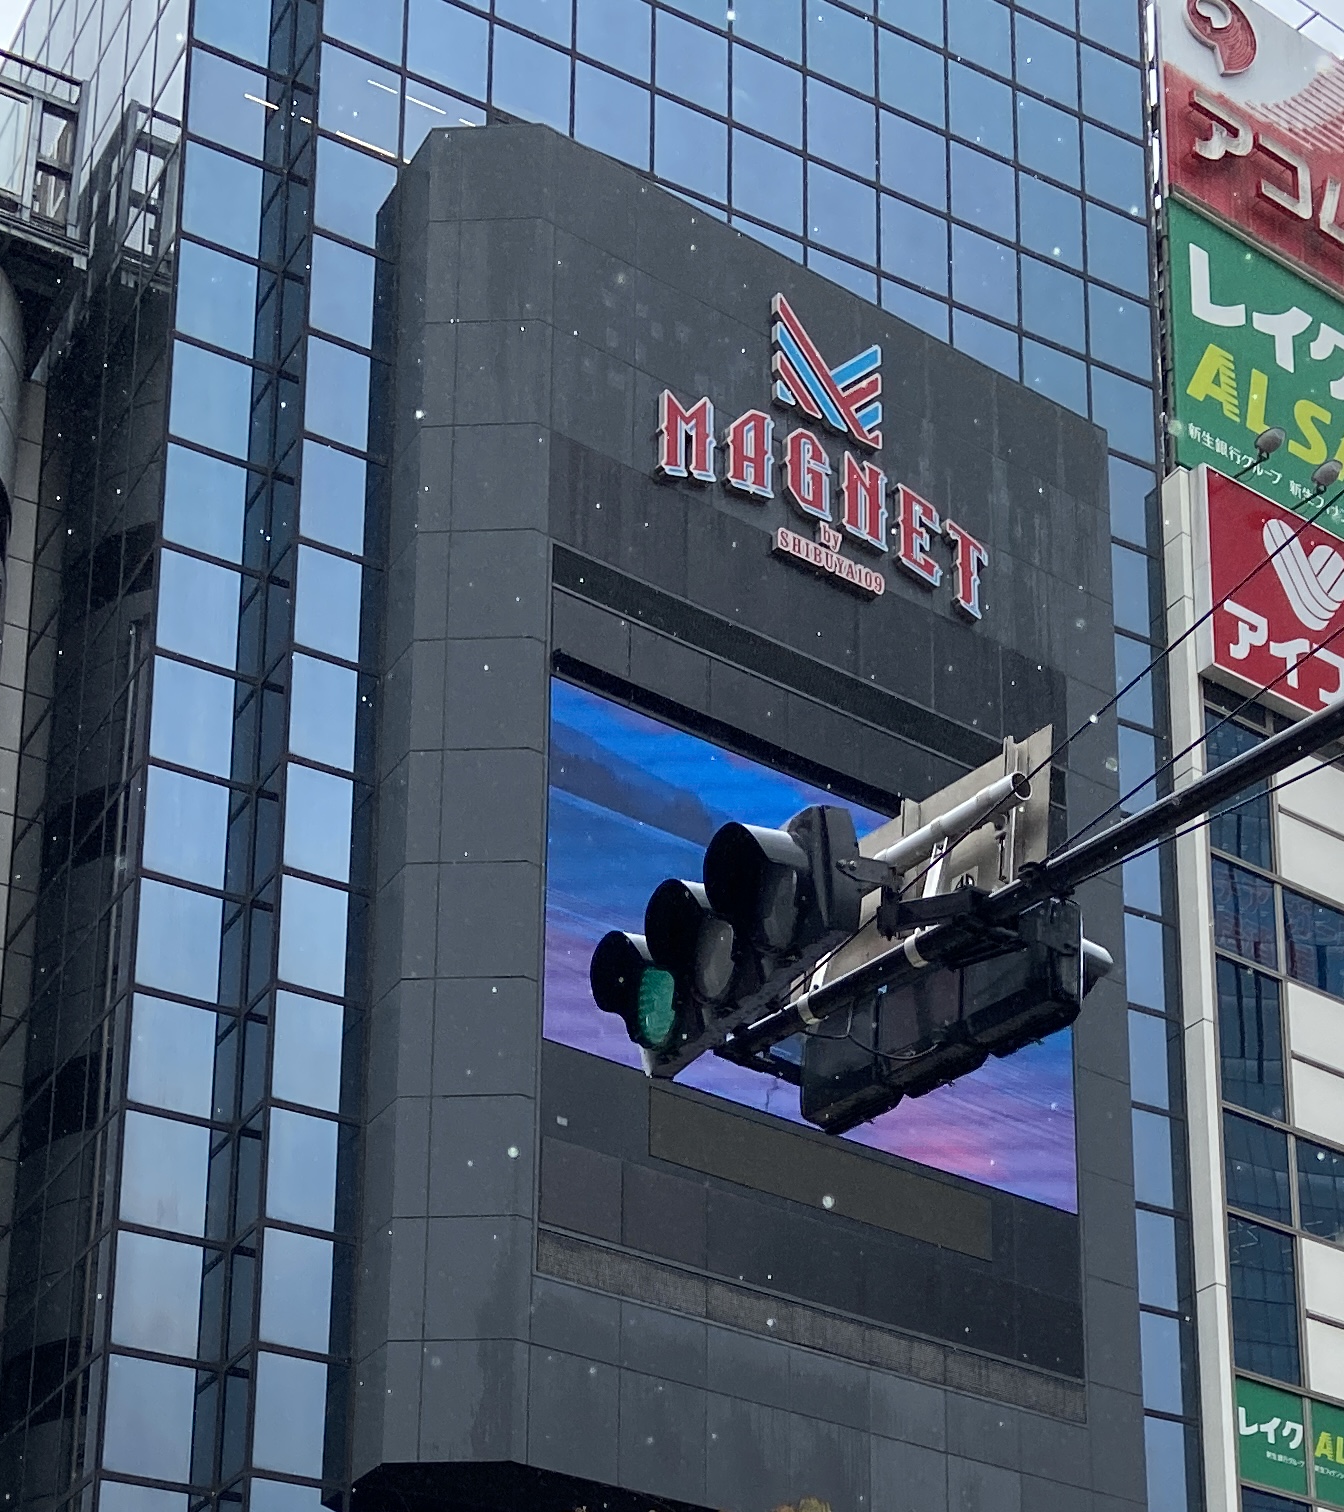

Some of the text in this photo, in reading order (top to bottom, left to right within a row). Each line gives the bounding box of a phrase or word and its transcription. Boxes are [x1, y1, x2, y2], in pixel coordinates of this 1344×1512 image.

[656, 388, 988, 620] MAGNET
[778, 527, 885, 595] SHIBUYA109
[820, 522, 843, 551] by
[1238, 1406, 1304, 1450] レイク
